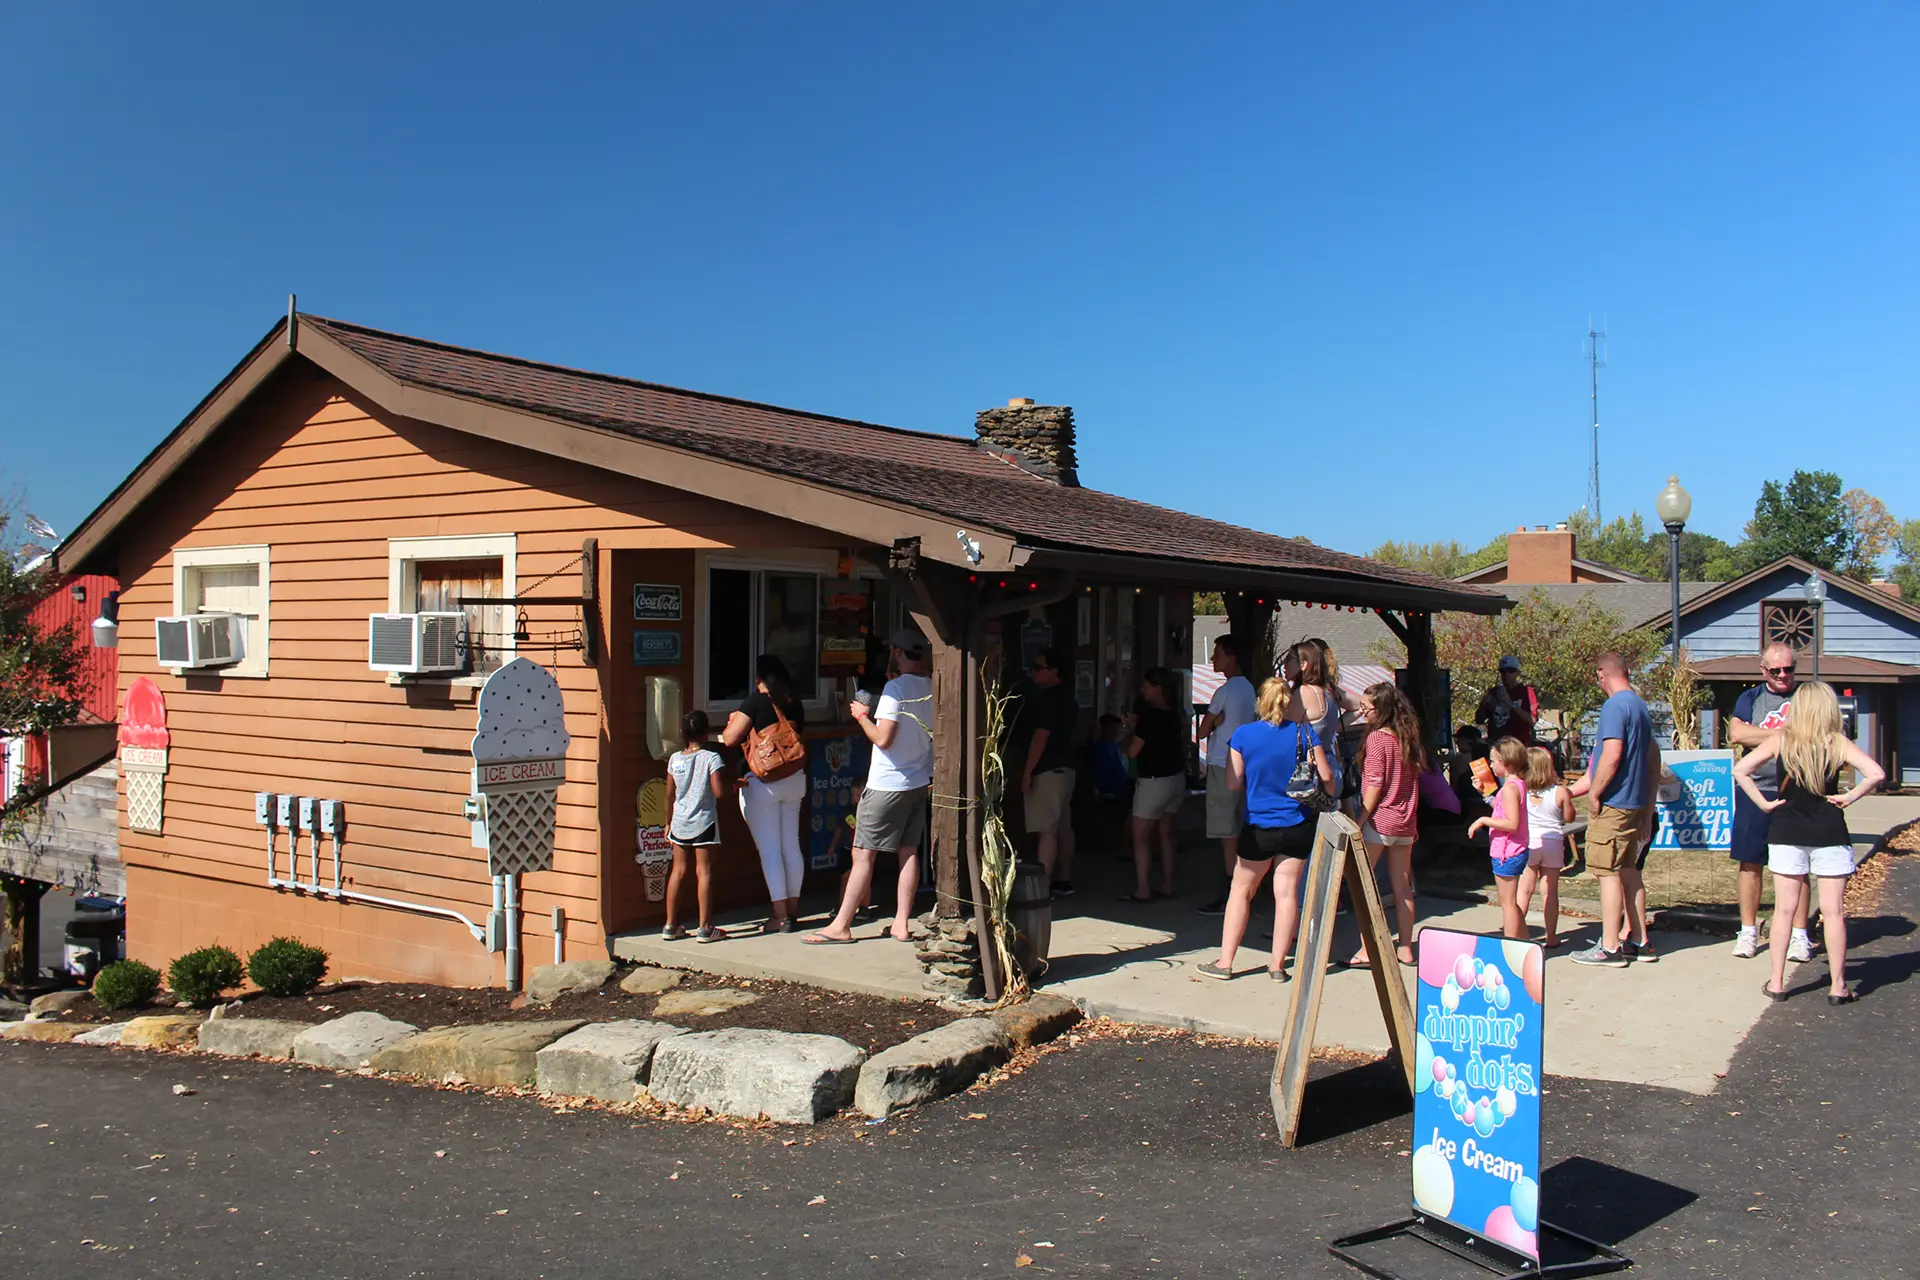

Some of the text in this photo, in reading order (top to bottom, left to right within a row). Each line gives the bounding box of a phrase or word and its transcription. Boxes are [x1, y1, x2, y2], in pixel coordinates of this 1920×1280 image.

[125, 750, 163, 764] ICE CREAM
[484, 762, 556, 782] ICE CREAM
[1692, 764, 1727, 775] Serving
[813, 775, 853, 790] Ice Crea
[1683, 778, 1715, 797] Soft
[1685, 793, 1728, 807] Serve
[1655, 803, 1730, 825] Frozen
[1656, 822, 1731, 845] Treats
[1424, 1005, 1524, 1051] dippin'
[1466, 1051, 1534, 1094] dots
[1431, 1126, 1523, 1185] Ice Cream
